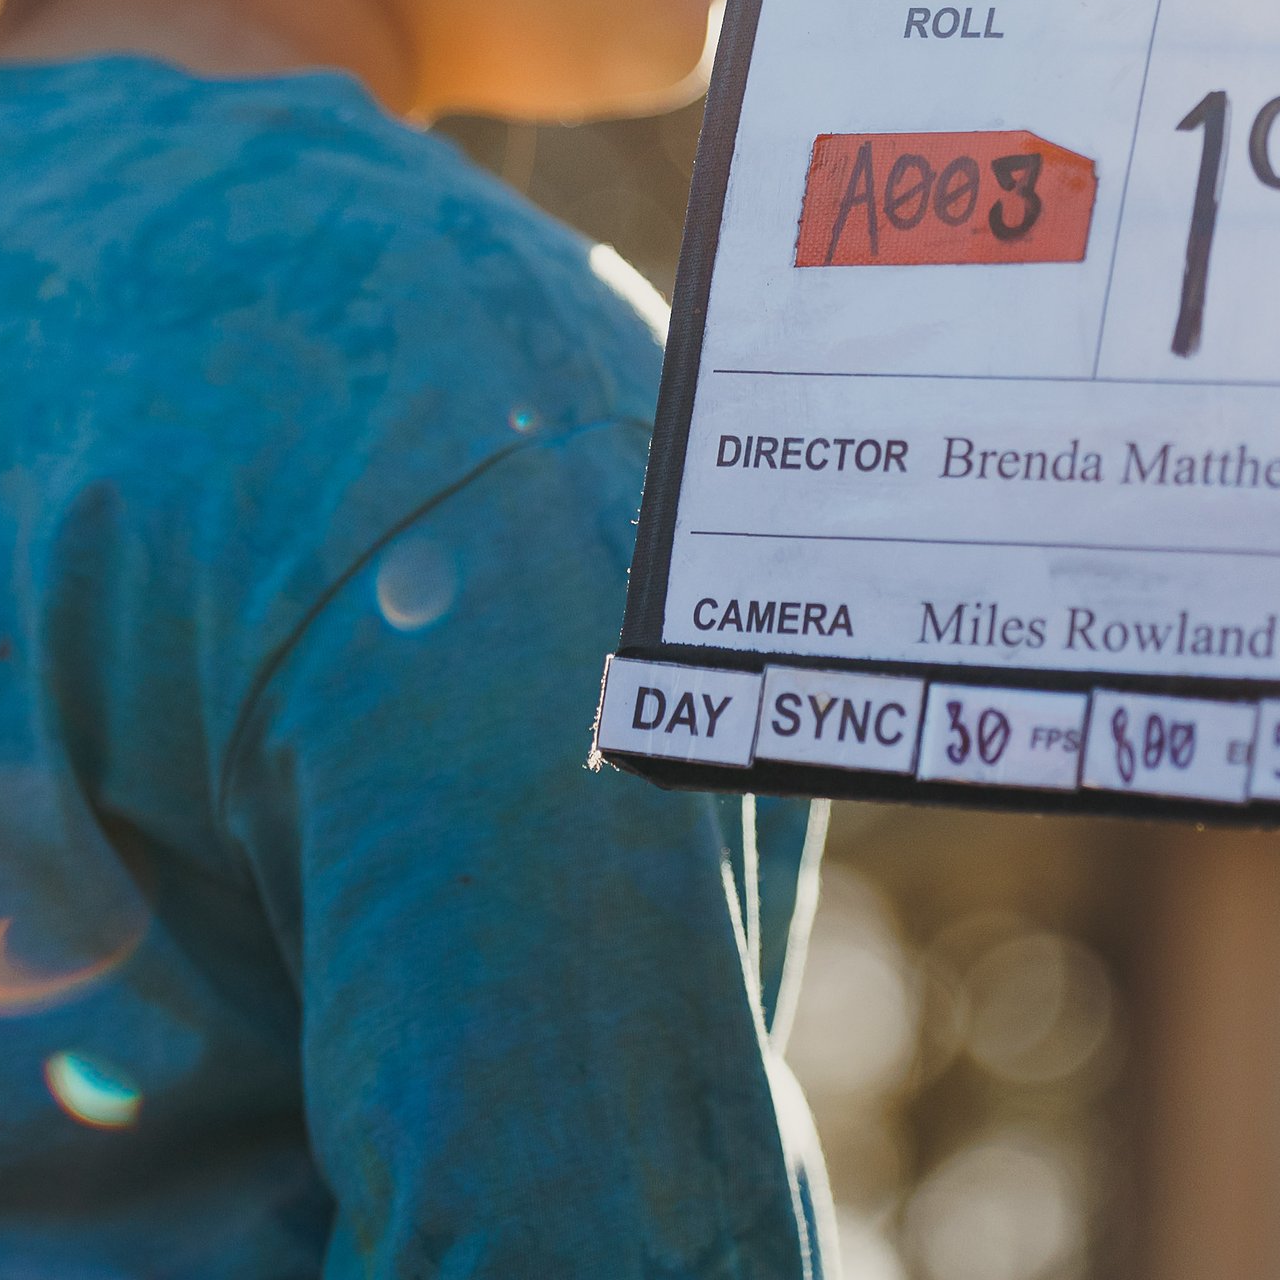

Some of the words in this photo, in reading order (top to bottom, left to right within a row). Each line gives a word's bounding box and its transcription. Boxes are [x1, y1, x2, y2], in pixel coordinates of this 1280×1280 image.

[903, 6, 1006, 39] ROLL
[824, 140, 1044, 266] A003
[715, 434, 909, 474] DIRECTOR
[938, 436, 1104, 484] Brenda
[692, 598, 854, 638] CAMERA
[917, 601, 1047, 650] Miles
[1064, 607, 1278, 660] Rowland
[632, 685, 733, 739] DAY
[770, 691, 908, 747] SYNC
[1028, 726, 1081, 753] FPS
